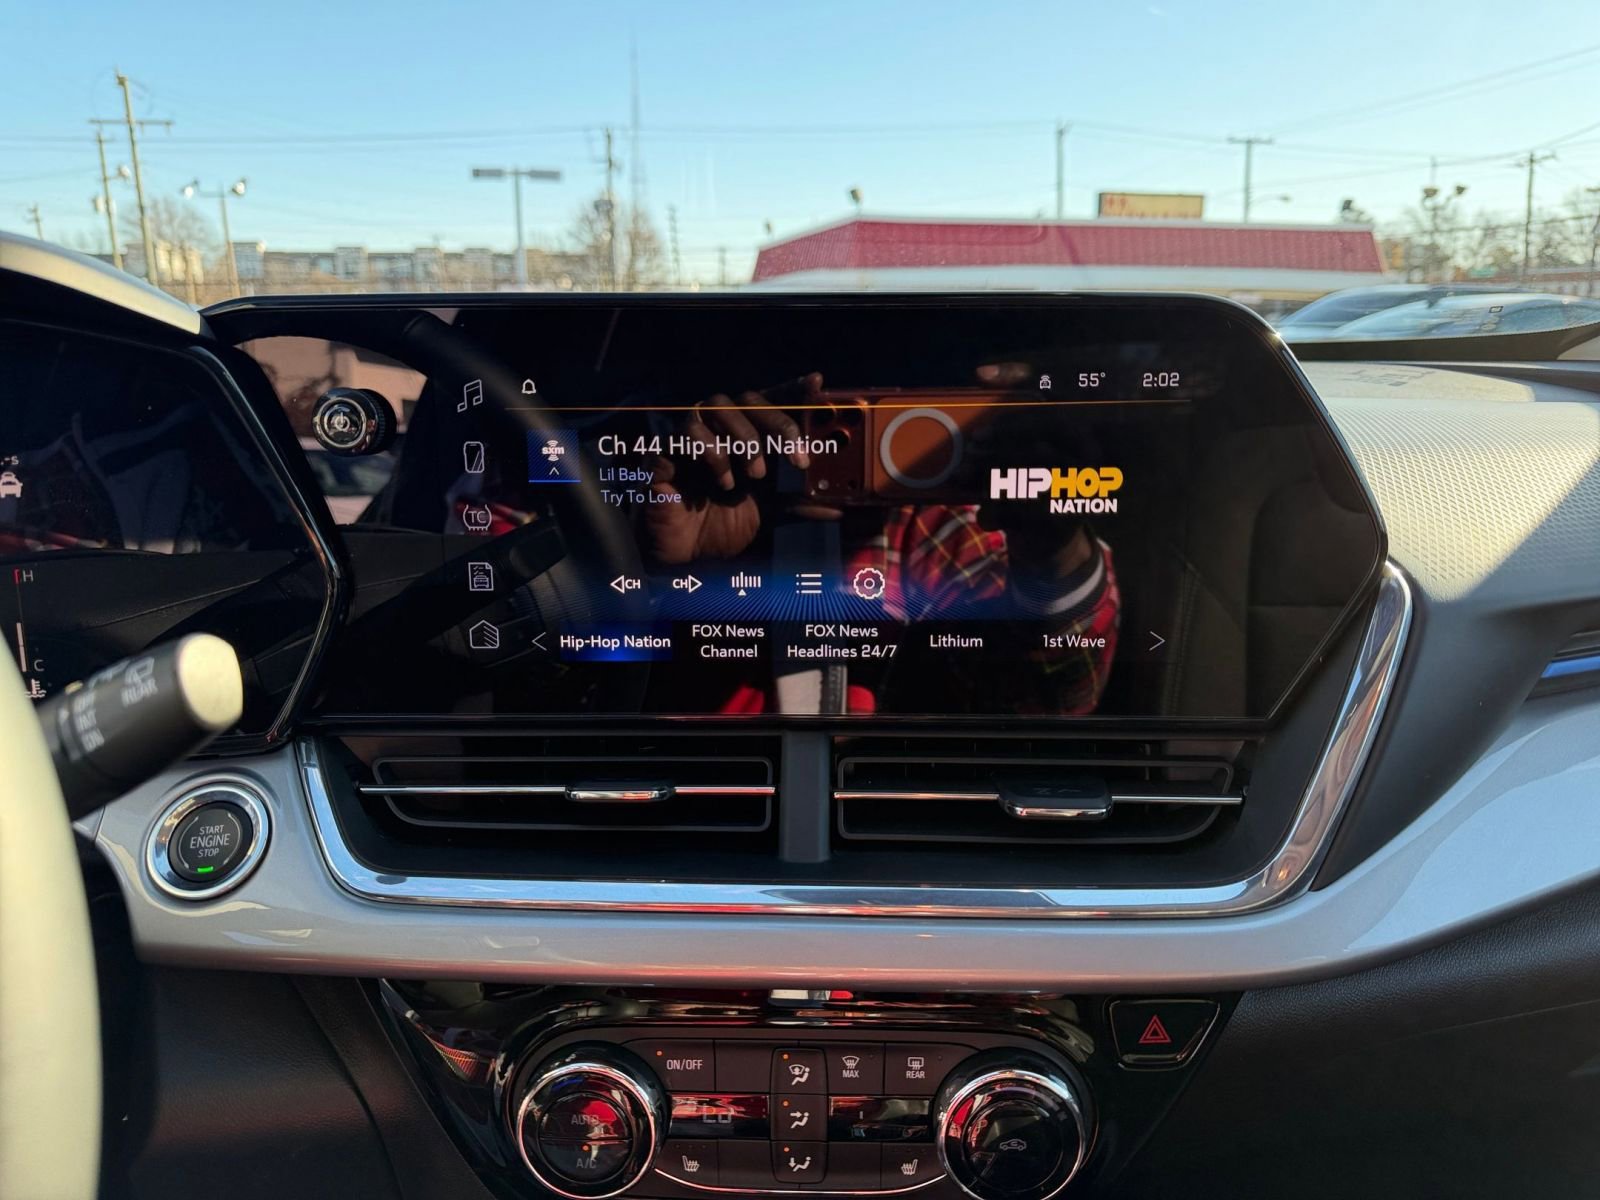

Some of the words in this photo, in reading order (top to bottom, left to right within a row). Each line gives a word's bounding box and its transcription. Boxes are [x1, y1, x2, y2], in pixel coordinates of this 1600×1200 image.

[1078, 372, 1106, 387] 55°
[1143, 372, 1180, 387] 2:02
[598, 435, 626, 455] Ch
[633, 435, 662, 455] 44
[669, 435, 760, 460] Hip-Hop
[767, 435, 838, 455] Nation
[599, 468, 615, 482] Lil
[619, 468, 654, 484] Baby
[601, 490, 624, 506] Try
[626, 490, 645, 504] To
[649, 490, 682, 504] Love
[1049, 498, 1118, 513] NATION
[468, 510, 487, 524] TC
[22, 569, 34, 582] H
[624, 578, 641, 590] CH
[672, 578, 688, 590] CH
[692, 624, 722, 637] FOX
[726, 624, 765, 637] News
[805, 624, 836, 637] FOX
[839, 624, 878, 637] News
[560, 635, 620, 650] Hip-Hop
[624, 635, 671, 648] Nation
[929, 634, 983, 648] Lithium
[1042, 634, 1062, 648] 1st
[1066, 634, 1106, 648] Wave
[700, 645, 758, 658] Channel
[787, 645, 857, 658] Headlines
[862, 645, 897, 658] 24/7
[33, 659, 45, 672] C
[199, 824, 225, 836] START
[190, 833, 231, 849] ENGINE
[198, 847, 219, 858] STOP
[666, 1059, 703, 1071] ON/OFF
[842, 1069, 860, 1079] MAX
[905, 1070, 926, 1079] REAR
[576, 1158, 598, 1169] A/C
